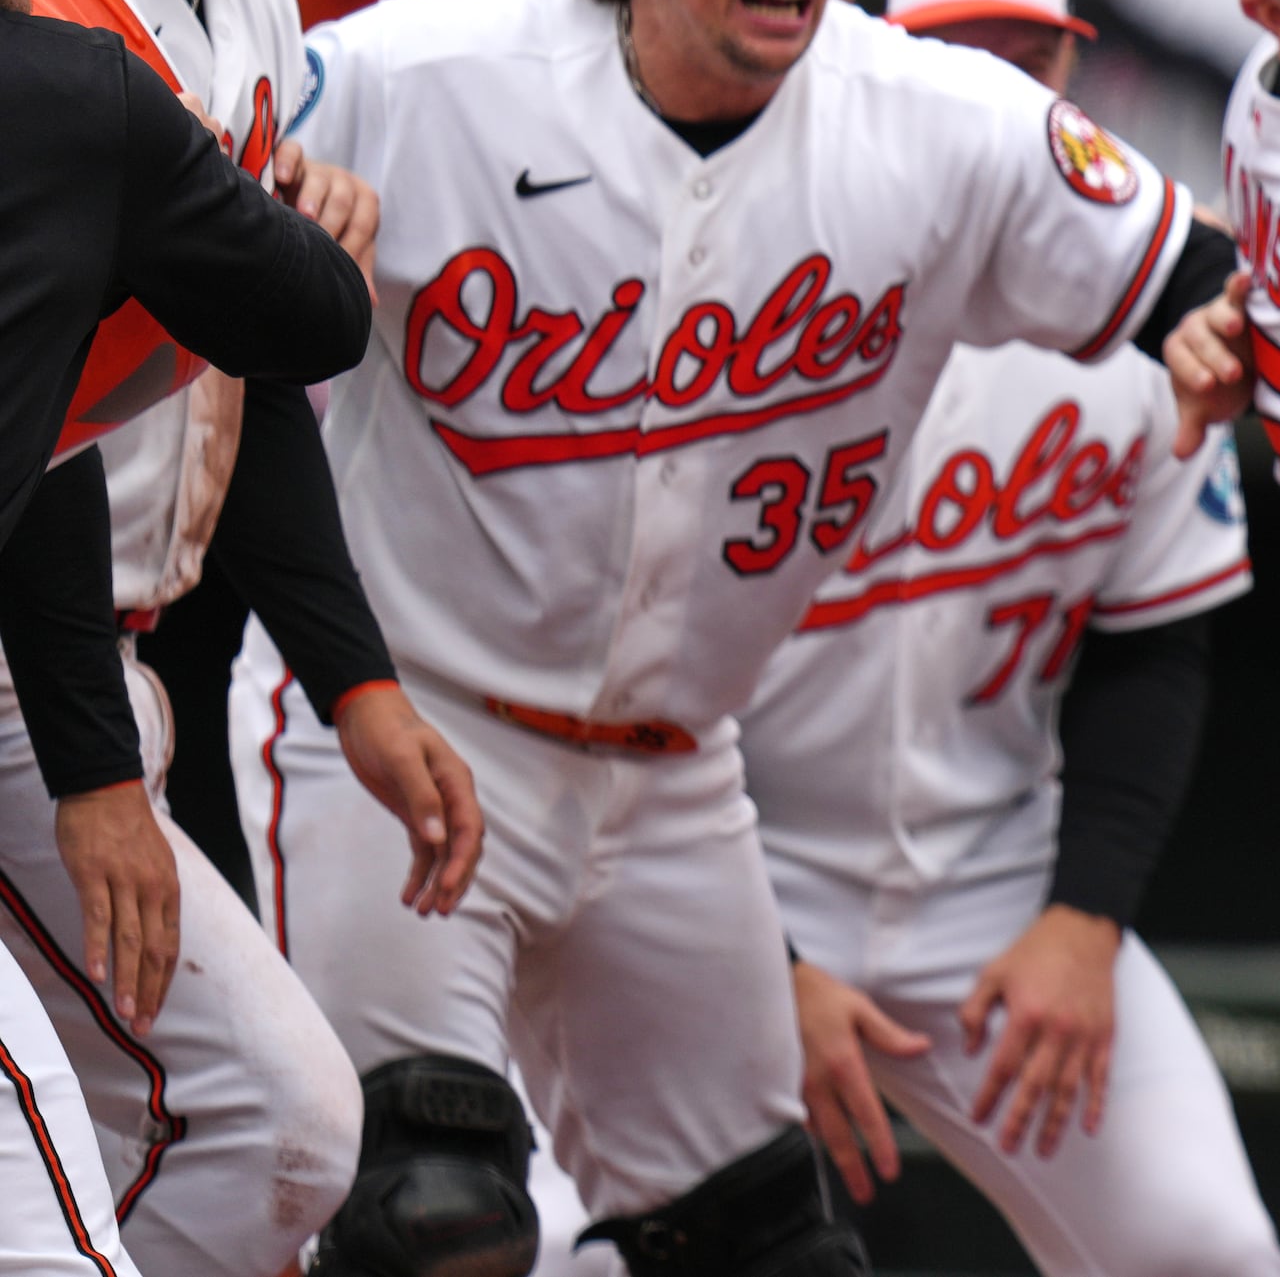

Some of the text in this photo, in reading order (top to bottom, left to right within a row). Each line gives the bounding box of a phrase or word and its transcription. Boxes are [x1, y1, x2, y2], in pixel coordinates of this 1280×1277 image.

[403, 245, 907, 414] Orioles
[723, 428, 890, 579] 35
[962, 591, 1096, 711] 71
